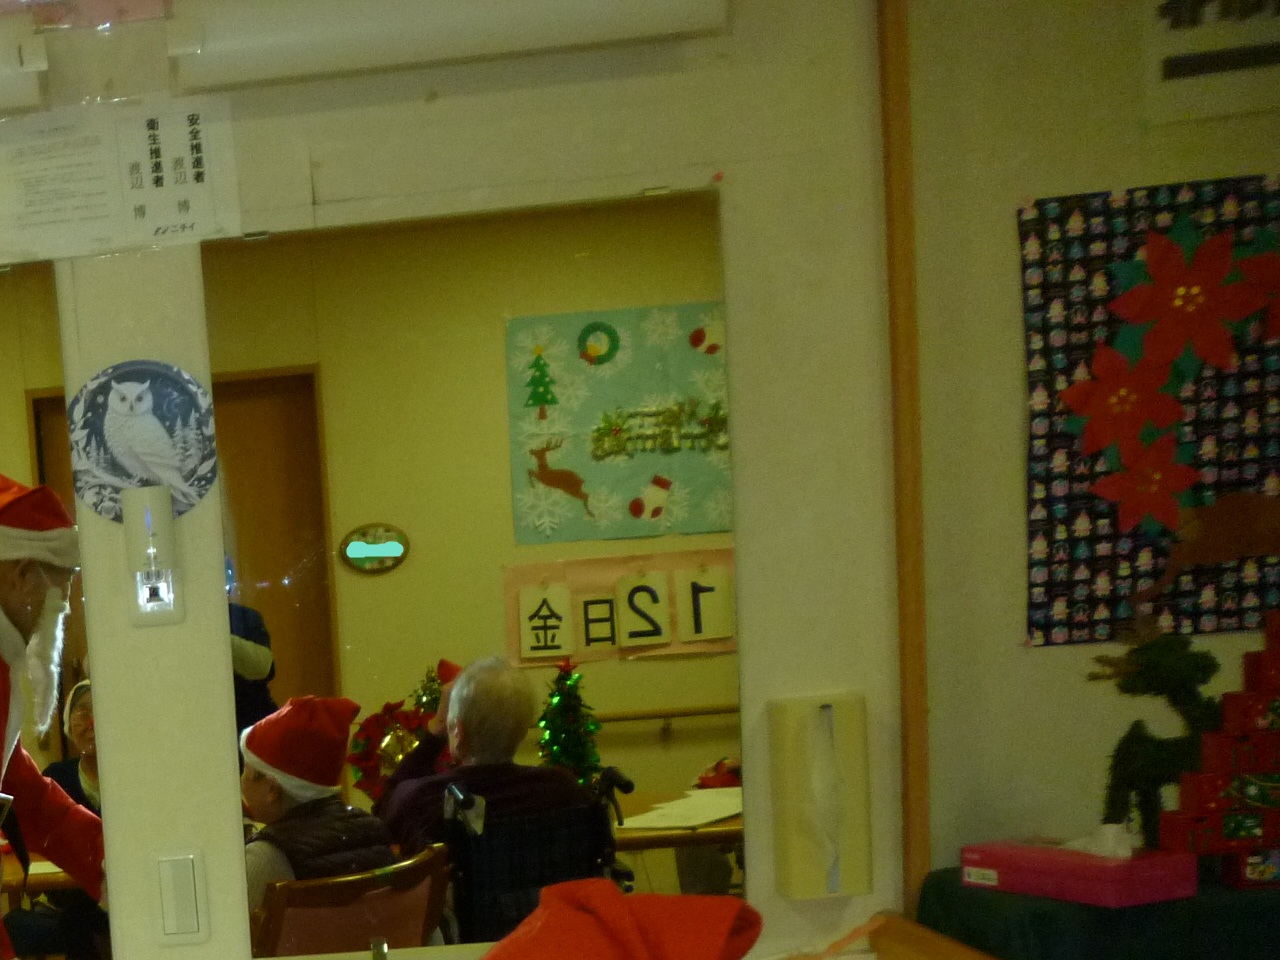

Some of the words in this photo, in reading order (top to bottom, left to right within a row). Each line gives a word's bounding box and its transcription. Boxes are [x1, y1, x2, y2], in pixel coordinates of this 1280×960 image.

[187, 113, 205, 183] 安全推進者
